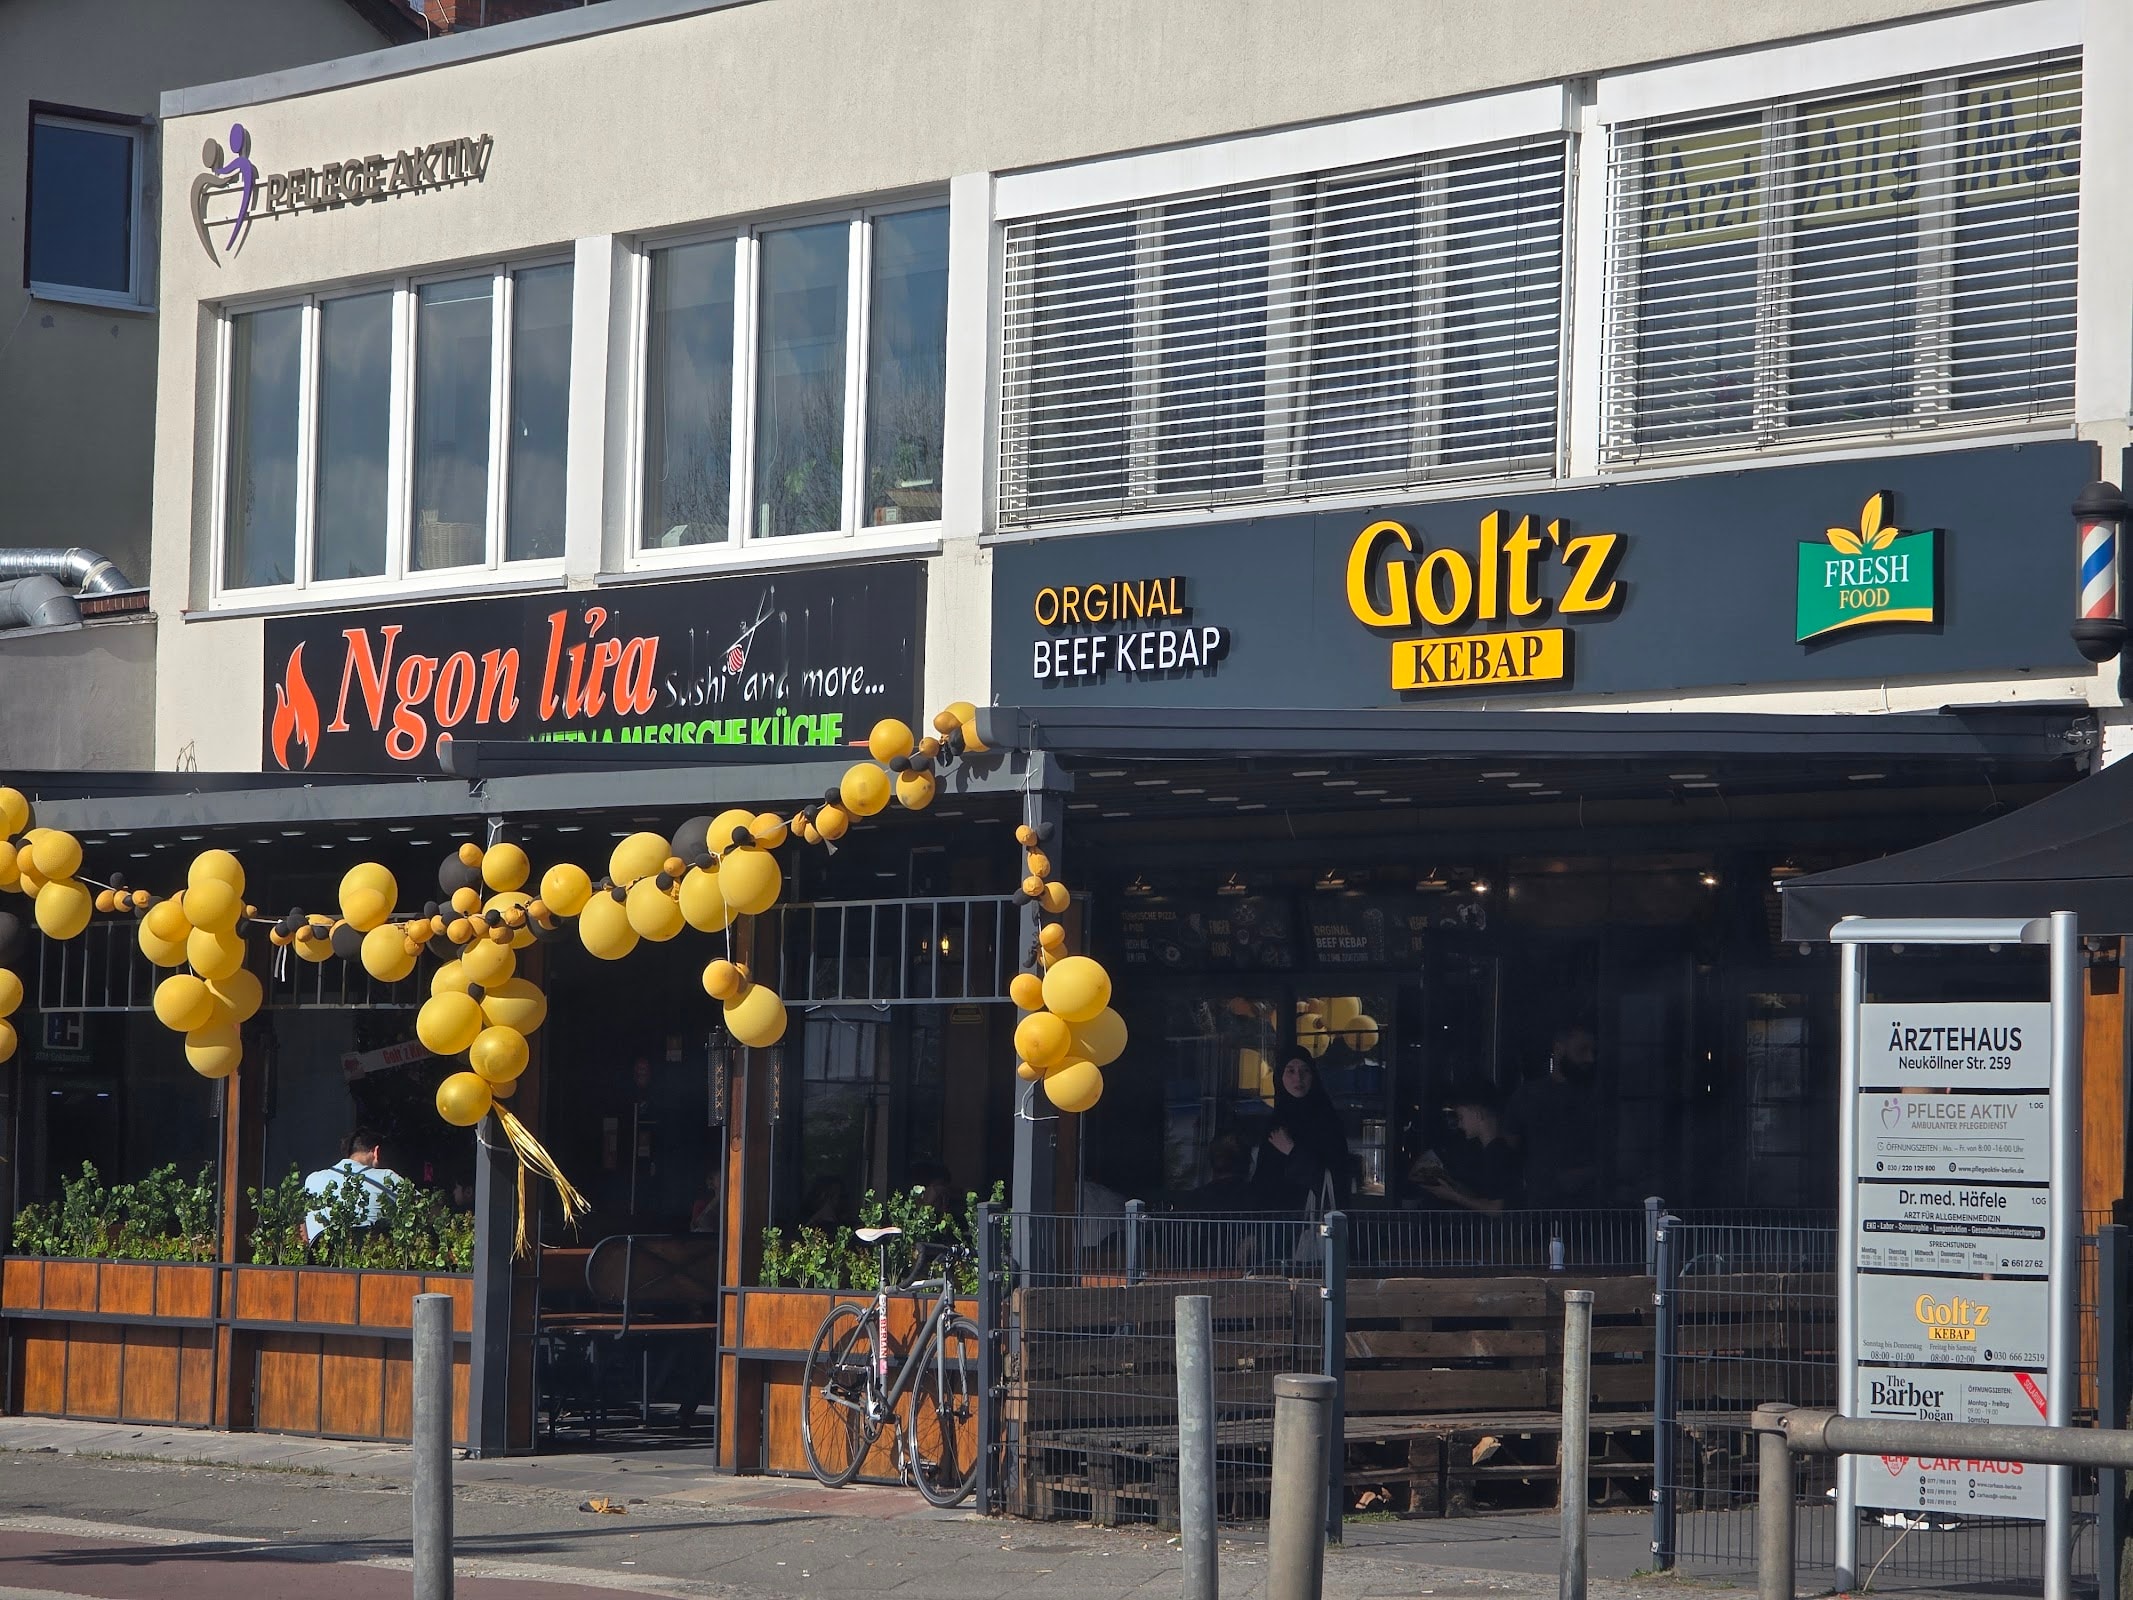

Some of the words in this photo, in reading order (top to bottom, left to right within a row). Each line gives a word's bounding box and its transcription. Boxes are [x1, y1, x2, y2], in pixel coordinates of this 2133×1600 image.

[266, 154, 382, 211] PFLEGE
[388, 134, 490, 190] AKTIV
[1657, 145, 1757, 236] Arzt
[1346, 510, 1618, 627] Golt'z
[1824, 554, 1909, 587] FRESH
[1034, 577, 1183, 626] ORGINAL
[1839, 588, 1890, 609] FOOD
[1033, 636, 1107, 679] BEEF
[1117, 626, 1221, 672] KEBAP
[1411, 635, 1544, 685] KEBAP
[751, 706, 844, 746] KÜCHE
[1316, 937, 1337, 948] BEEF
[1339, 937, 1367, 948] KEBAP
[1889, 1022, 2022, 1051] ÄRZTEHAUS
[1899, 1056, 1964, 1070] Neuköllner
[1966, 1056, 1986, 1070] Str.
[1989, 1056, 2011, 1070] 259
[1907, 1103, 1966, 1119] PFLEGE
[1970, 1103, 2018, 1119] AKTIV
[1911, 1121, 1957, 1130] AMBULANTER
[1959, 1121, 2007, 1130] PFLEGEDIENST
[1899, 1190, 1917, 1205] Dr.
[1920, 1190, 1955, 1206] med.
[1959, 1191, 2007, 1208] Häfele
[1904, 1211, 1920, 1220] ARZT
[1921, 1211, 1934, 1220] FÜR
[1935, 1212, 2001, 1223] ALLGEMEINMEDIZIN
[1929, 1240, 1976, 1249] SPRECHSTUNDEN
[2024, 1260, 2033, 1268] 27
[2034, 1260, 2044, 1268] 62
[1934, 1328, 1970, 1340] KEBAP
[1863, 1340, 1885, 1349] Sonntag
[1893, 1341, 1922, 1351] Donnerstag
[1929, 1343, 1947, 1351] Freitag
[1947, 1343, 1956, 1351] bis
[1956, 1344, 1977, 1353] Samstag
[1871, 1350, 1890, 1360] 08:00
[1895, 1351, 1915, 1361] 01:00
[1930, 1353, 1950, 1363] 08:00
[1955, 1354, 1975, 1364] 02:00
[1994, 1352, 2007, 1361] 030
[2009, 1353, 2022, 1361] 666
[2023, 1353, 2045, 1362] 22519
[1886, 1375, 1906, 1387] The
[1870, 1381, 1944, 1408] Barber
[1919, 1408, 1953, 1422] Doğan
[1917, 1457, 1960, 1472] CAR
[1967, 1458, 2025, 1475] HAUS
